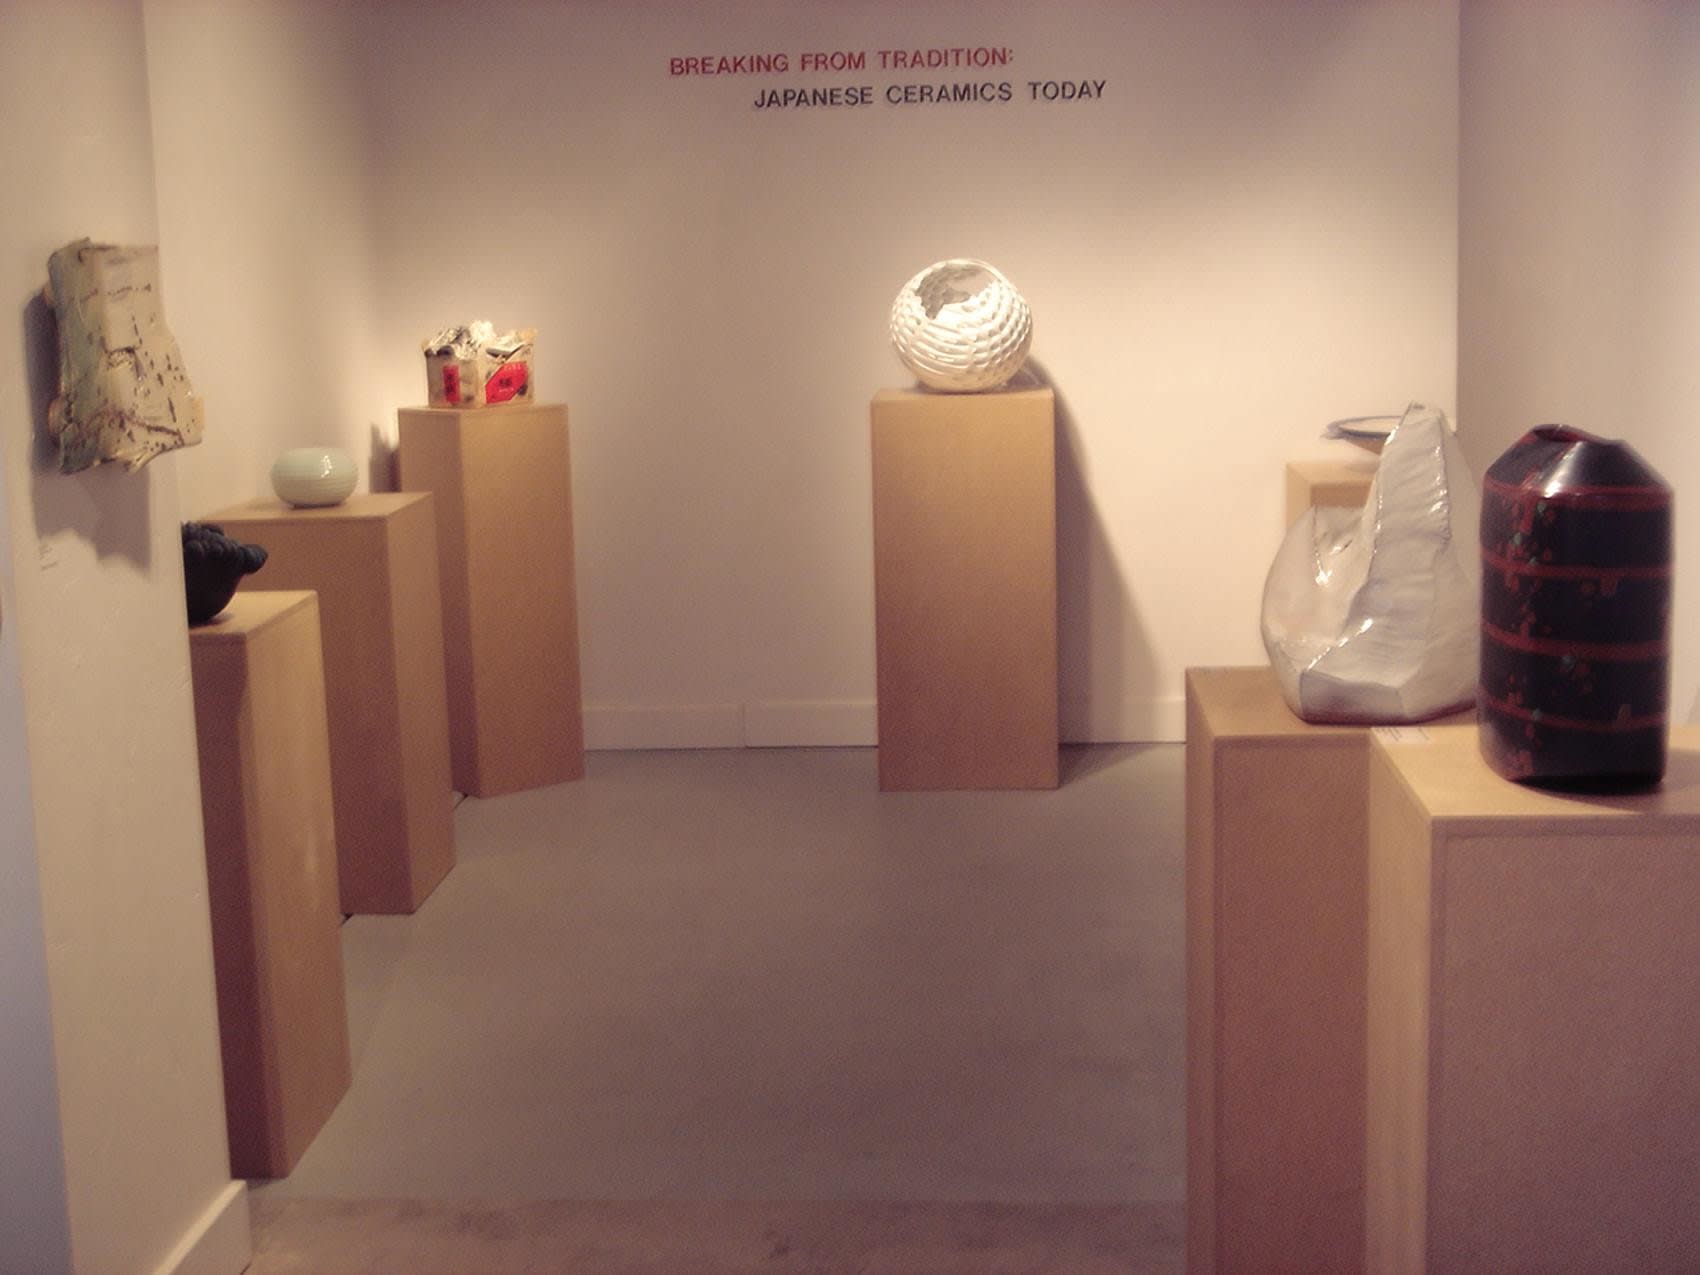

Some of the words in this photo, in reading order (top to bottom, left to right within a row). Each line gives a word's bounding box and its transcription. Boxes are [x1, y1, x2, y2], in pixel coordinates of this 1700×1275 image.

[669, 54, 789, 76] BREAKING
[800, 51, 866, 72] FROM
[877, 47, 1014, 69] TRADITION:
[753, 86, 874, 109] JAPANESE
[885, 82, 1013, 105] CERAMICS
[1027, 79, 1107, 101] TODAY
